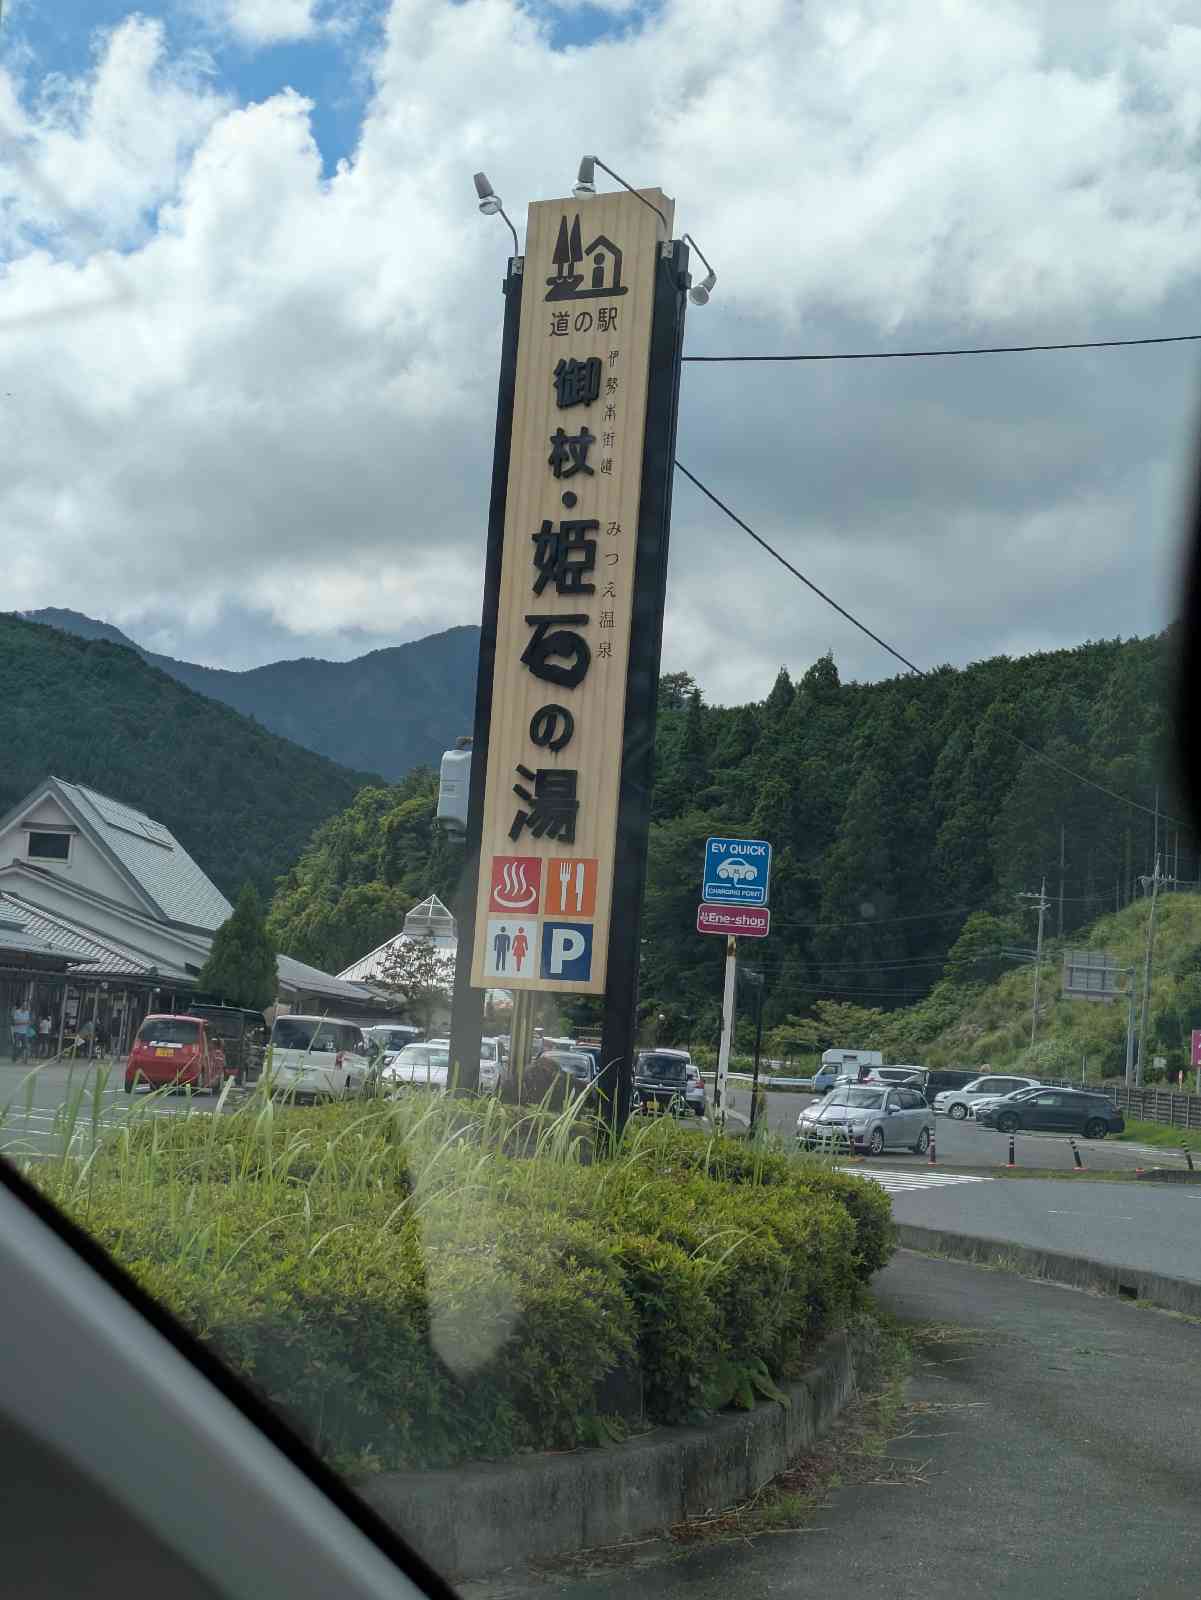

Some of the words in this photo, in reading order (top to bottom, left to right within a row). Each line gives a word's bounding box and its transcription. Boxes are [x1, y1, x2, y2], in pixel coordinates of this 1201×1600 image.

[549, 307, 618, 338] 道の駅
[596, 520, 622, 659] みつえ温泉
[711, 843, 727, 854] EV
[729, 844, 766, 856] QUICK
[708, 887, 741, 896] CHARGING
[741, 889, 761, 898] POINT
[551, 928, 585, 975] P
